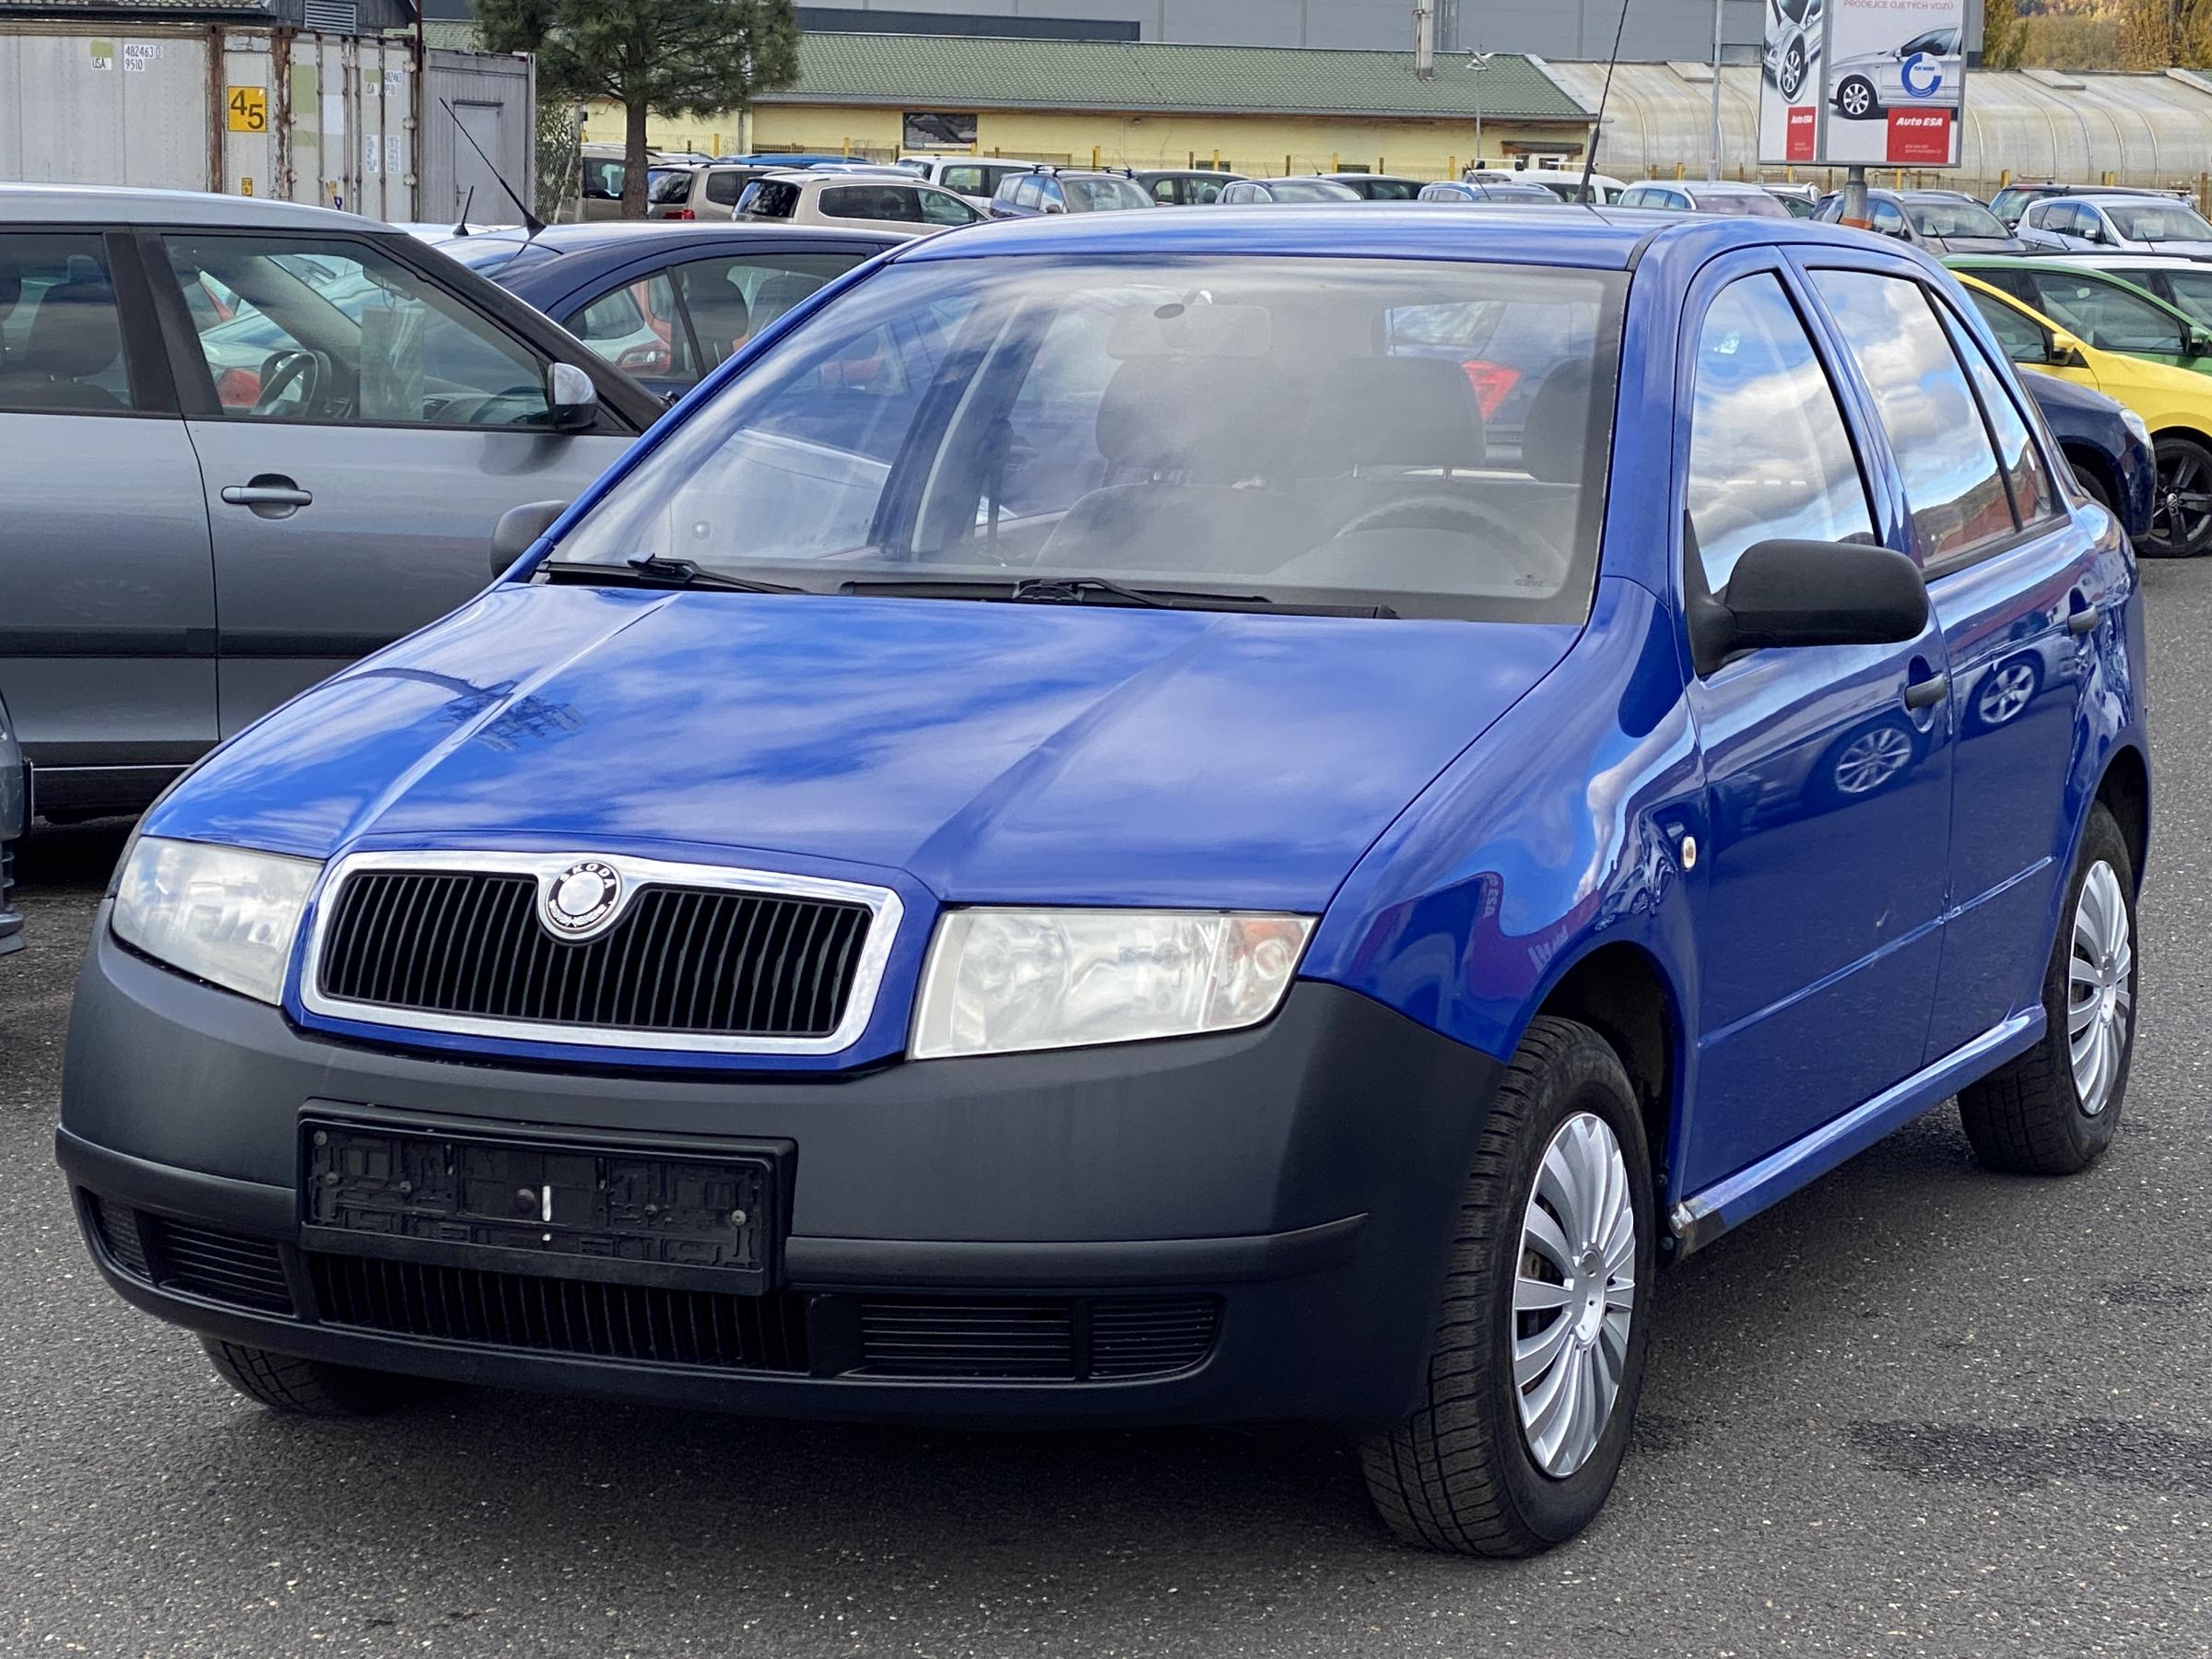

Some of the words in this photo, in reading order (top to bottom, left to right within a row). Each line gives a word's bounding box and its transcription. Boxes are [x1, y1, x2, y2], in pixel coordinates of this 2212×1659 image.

[125, 45, 154, 57] 482463
[93, 57, 106, 69] USA
[125, 58, 143, 70] 9510
[1896, 117, 1923, 126] Auto
[1923, 117, 1943, 126] ESA
